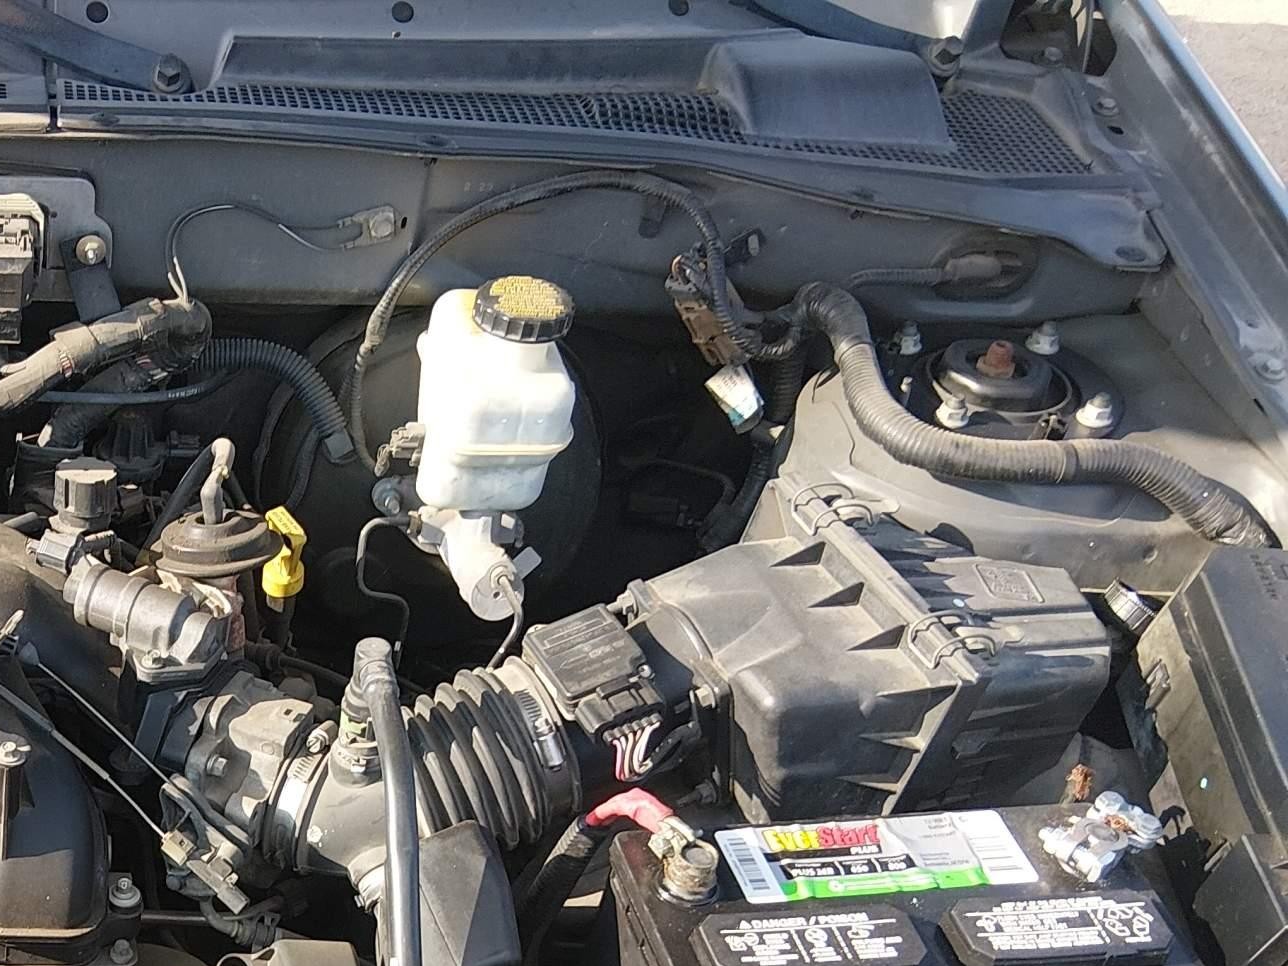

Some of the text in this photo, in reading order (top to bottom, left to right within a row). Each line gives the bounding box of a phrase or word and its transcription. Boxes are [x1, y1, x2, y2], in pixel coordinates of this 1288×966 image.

[763, 823, 880, 851] EverStart
[751, 916, 807, 929] DANGER
[818, 913, 869, 925] POISON
